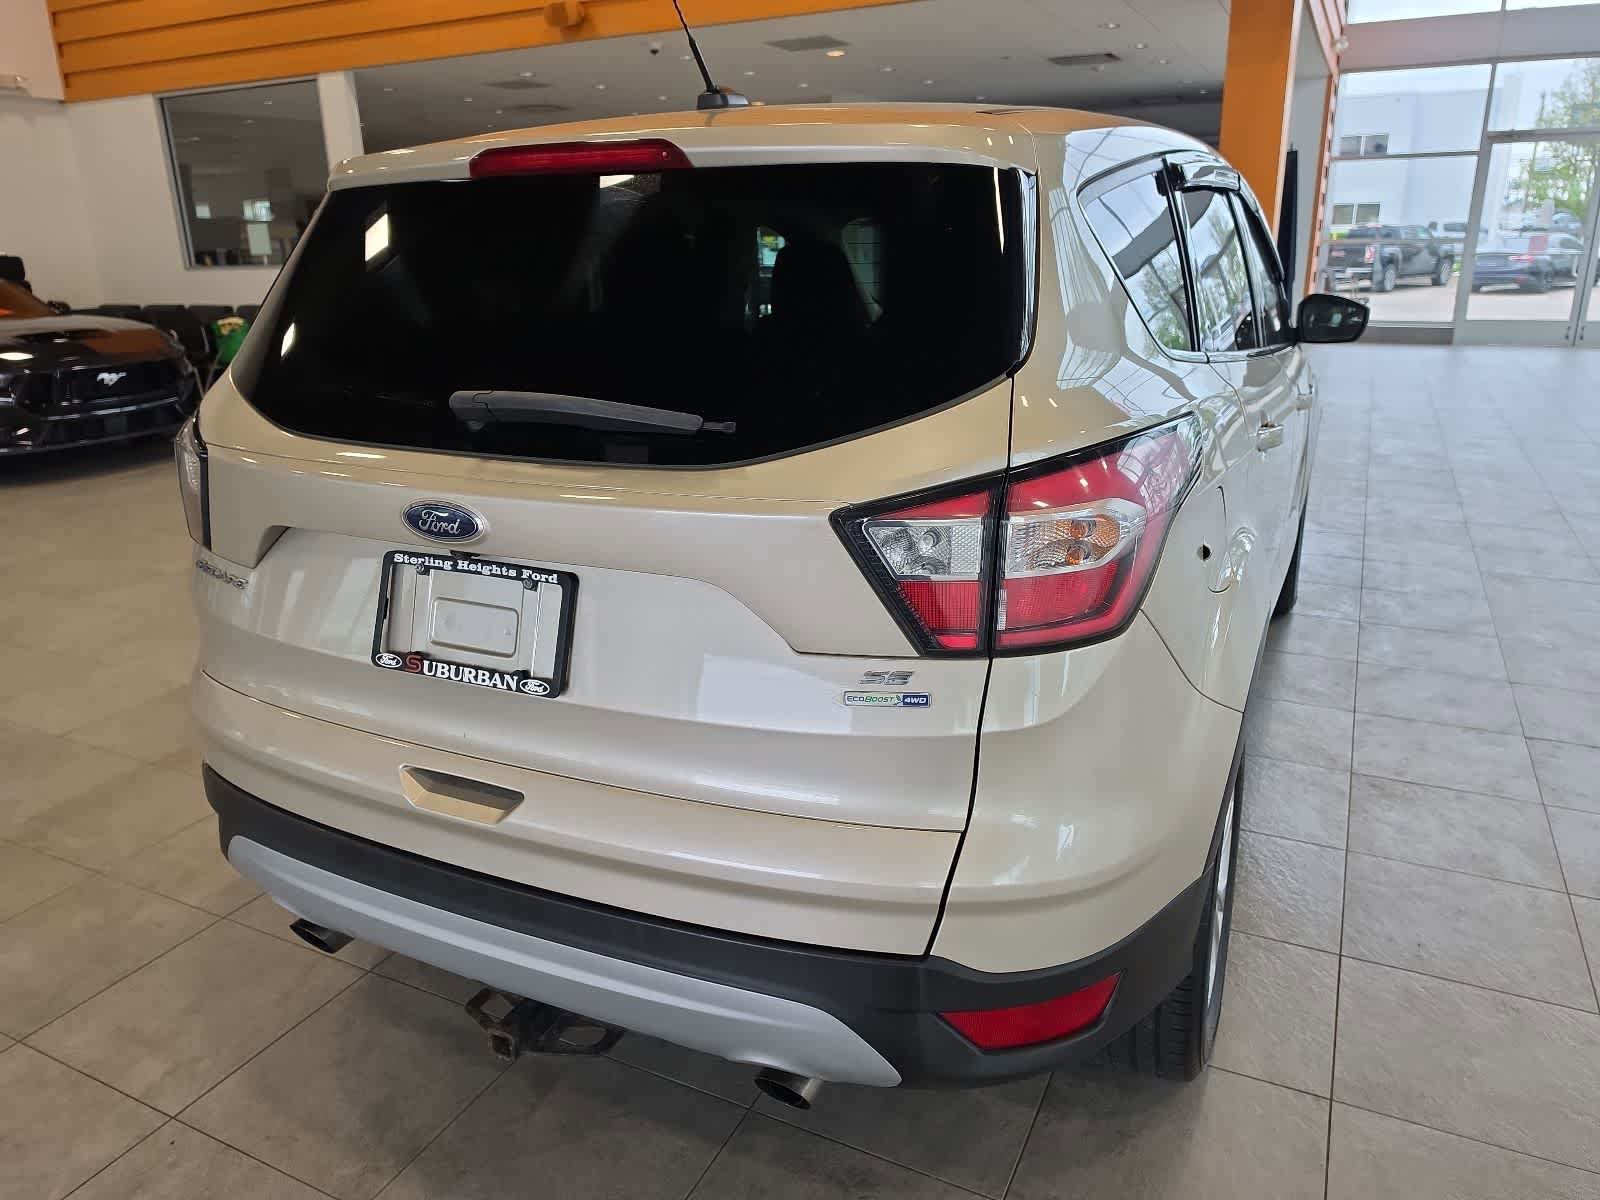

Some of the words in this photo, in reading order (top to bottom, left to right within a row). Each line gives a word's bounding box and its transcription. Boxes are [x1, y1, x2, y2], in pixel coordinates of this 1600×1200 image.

[418, 509, 461, 535] Ford
[393, 553, 453, 570] Sterling
[456, 560, 517, 577] Heights
[521, 569, 558, 583] Ford
[405, 654, 518, 691] SUBURBAN
[904, 696, 927, 704] 4WD
